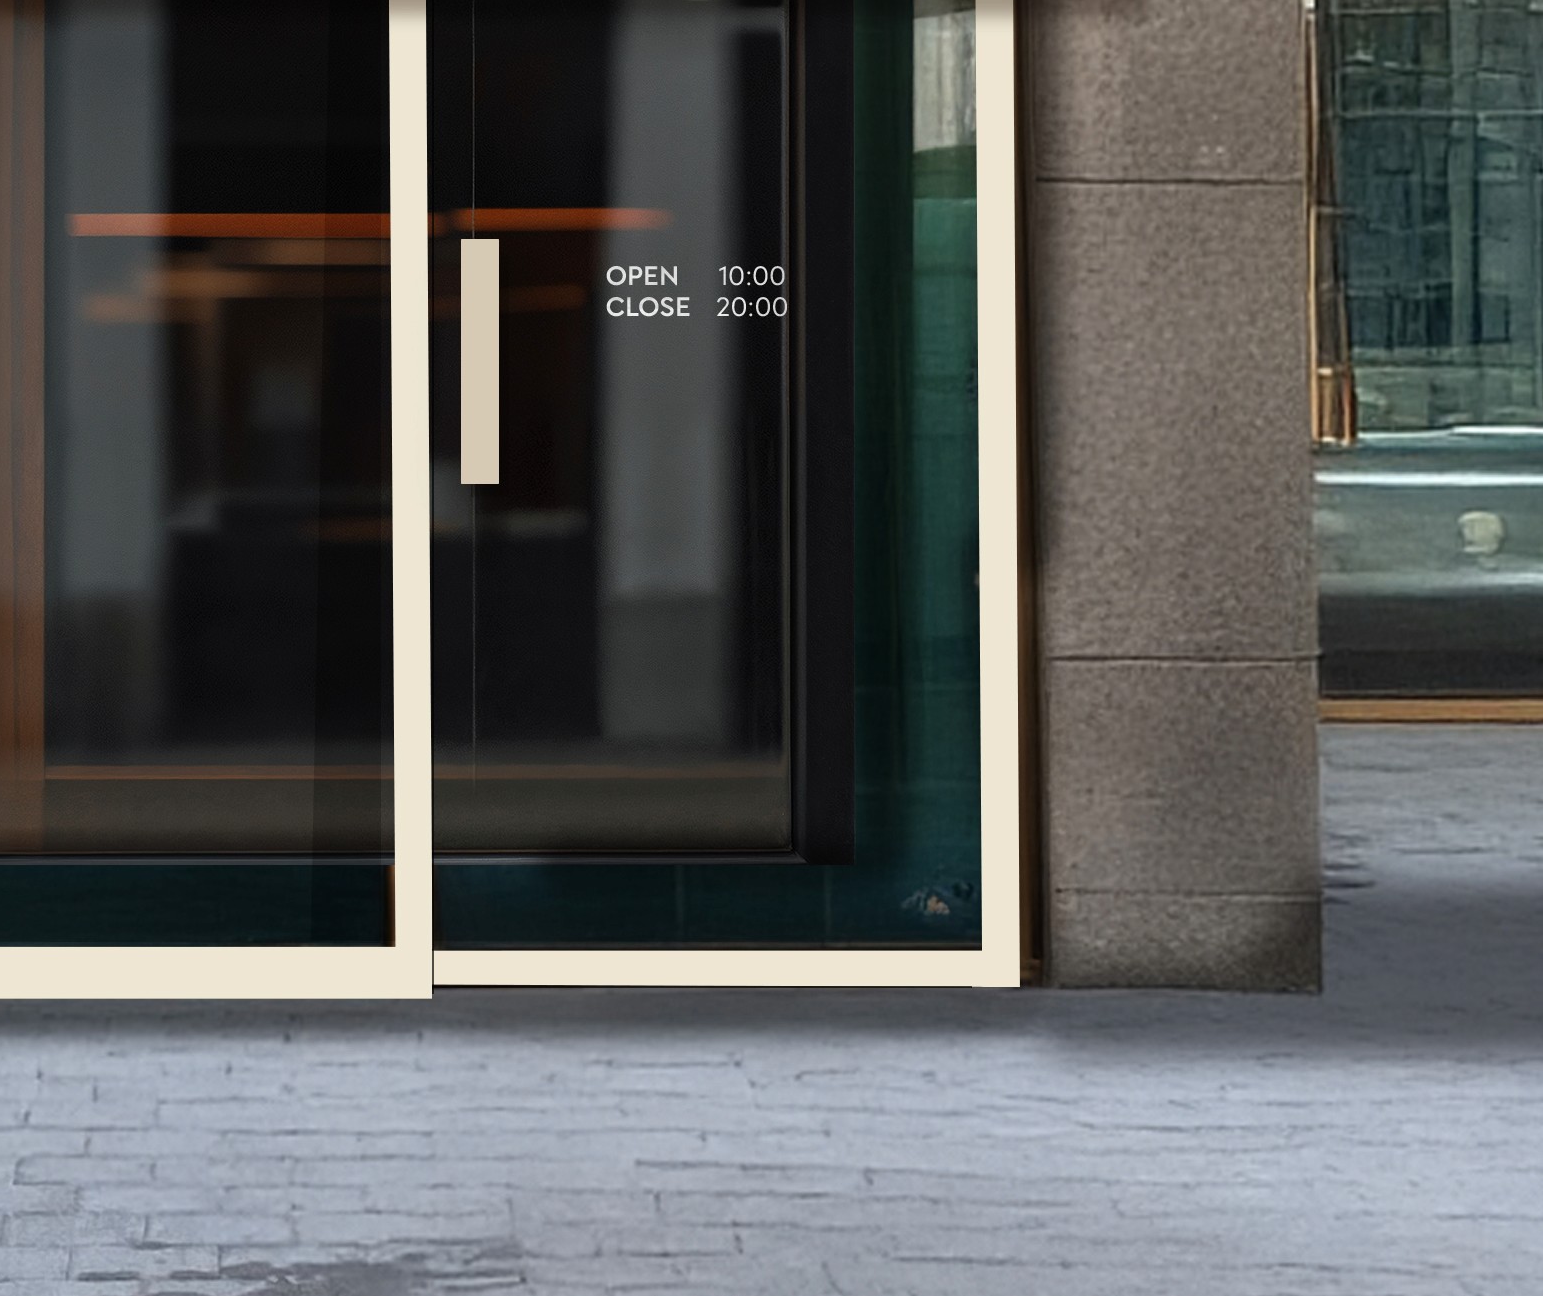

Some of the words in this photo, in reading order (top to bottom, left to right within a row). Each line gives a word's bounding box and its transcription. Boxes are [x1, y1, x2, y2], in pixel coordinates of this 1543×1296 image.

[606, 265, 678, 286] OPEN
[718, 265, 786, 286] 10:00
[606, 296, 691, 317] CLOSE
[716, 296, 788, 317] 20:00
